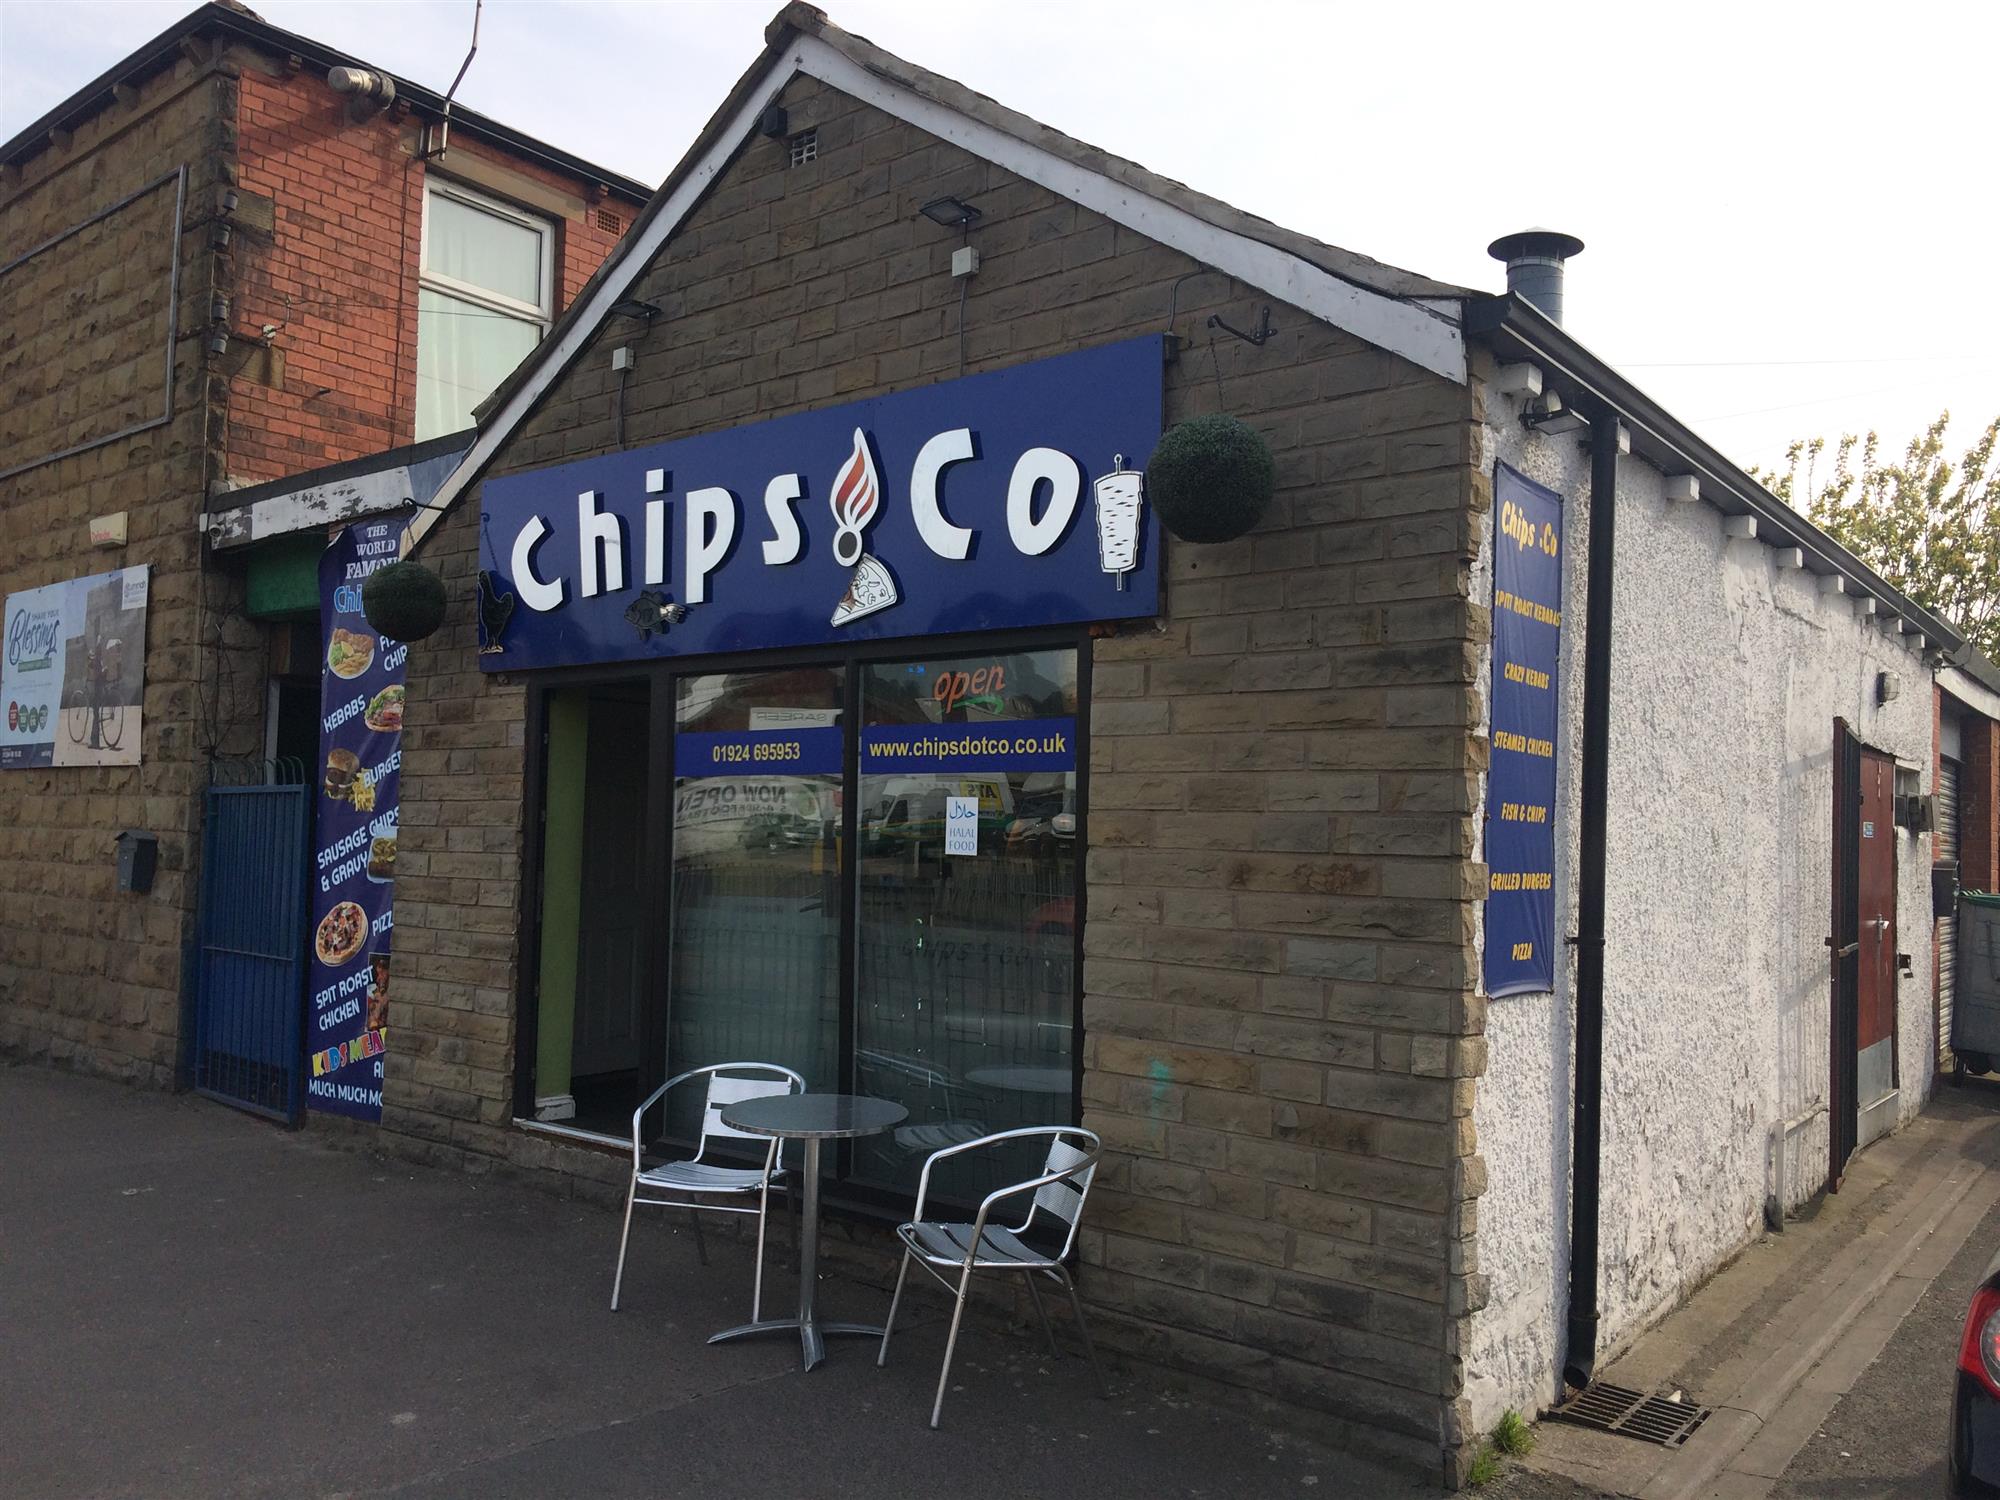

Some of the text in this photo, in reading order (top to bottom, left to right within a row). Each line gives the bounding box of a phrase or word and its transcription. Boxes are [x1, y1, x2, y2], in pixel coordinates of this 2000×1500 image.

[366, 524, 388, 538] THE
[1501, 500, 1536, 553] Chips
[356, 539, 397, 557] WORLD
[345, 556, 400, 580] FAM
[9, 608, 60, 666] Blessings
[384, 644, 408, 672] CHIP
[1504, 661, 1525, 683] CRAZY
[933, 664, 1006, 714] open
[323, 694, 366, 734] KEBABS
[713, 742, 800, 762] 01924 695953
[869, 733, 1066, 760] www.chipsdotco.co.uk
[1494, 730, 1526, 753] STEAMED
[1501, 802, 1518, 822] FISH
[1527, 805, 1547, 824] CHIPS
[317, 826, 368, 870] SAUSAGE
[949, 840, 975, 851] FOOD
[320, 850, 368, 892] & GRAVY
[1490, 872, 1551, 891] GRILLED BURGERS
[372, 910, 394, 937] PIZZ
[1511, 942, 1533, 962] PIZZA
[316, 965, 375, 1010] SPIT ROAST
[319, 997, 361, 1031] CHICKEN
[312, 1042, 347, 1077] KIDS
[308, 1078, 336, 1100] MUCH
[338, 1084, 366, 1105] MUCH
